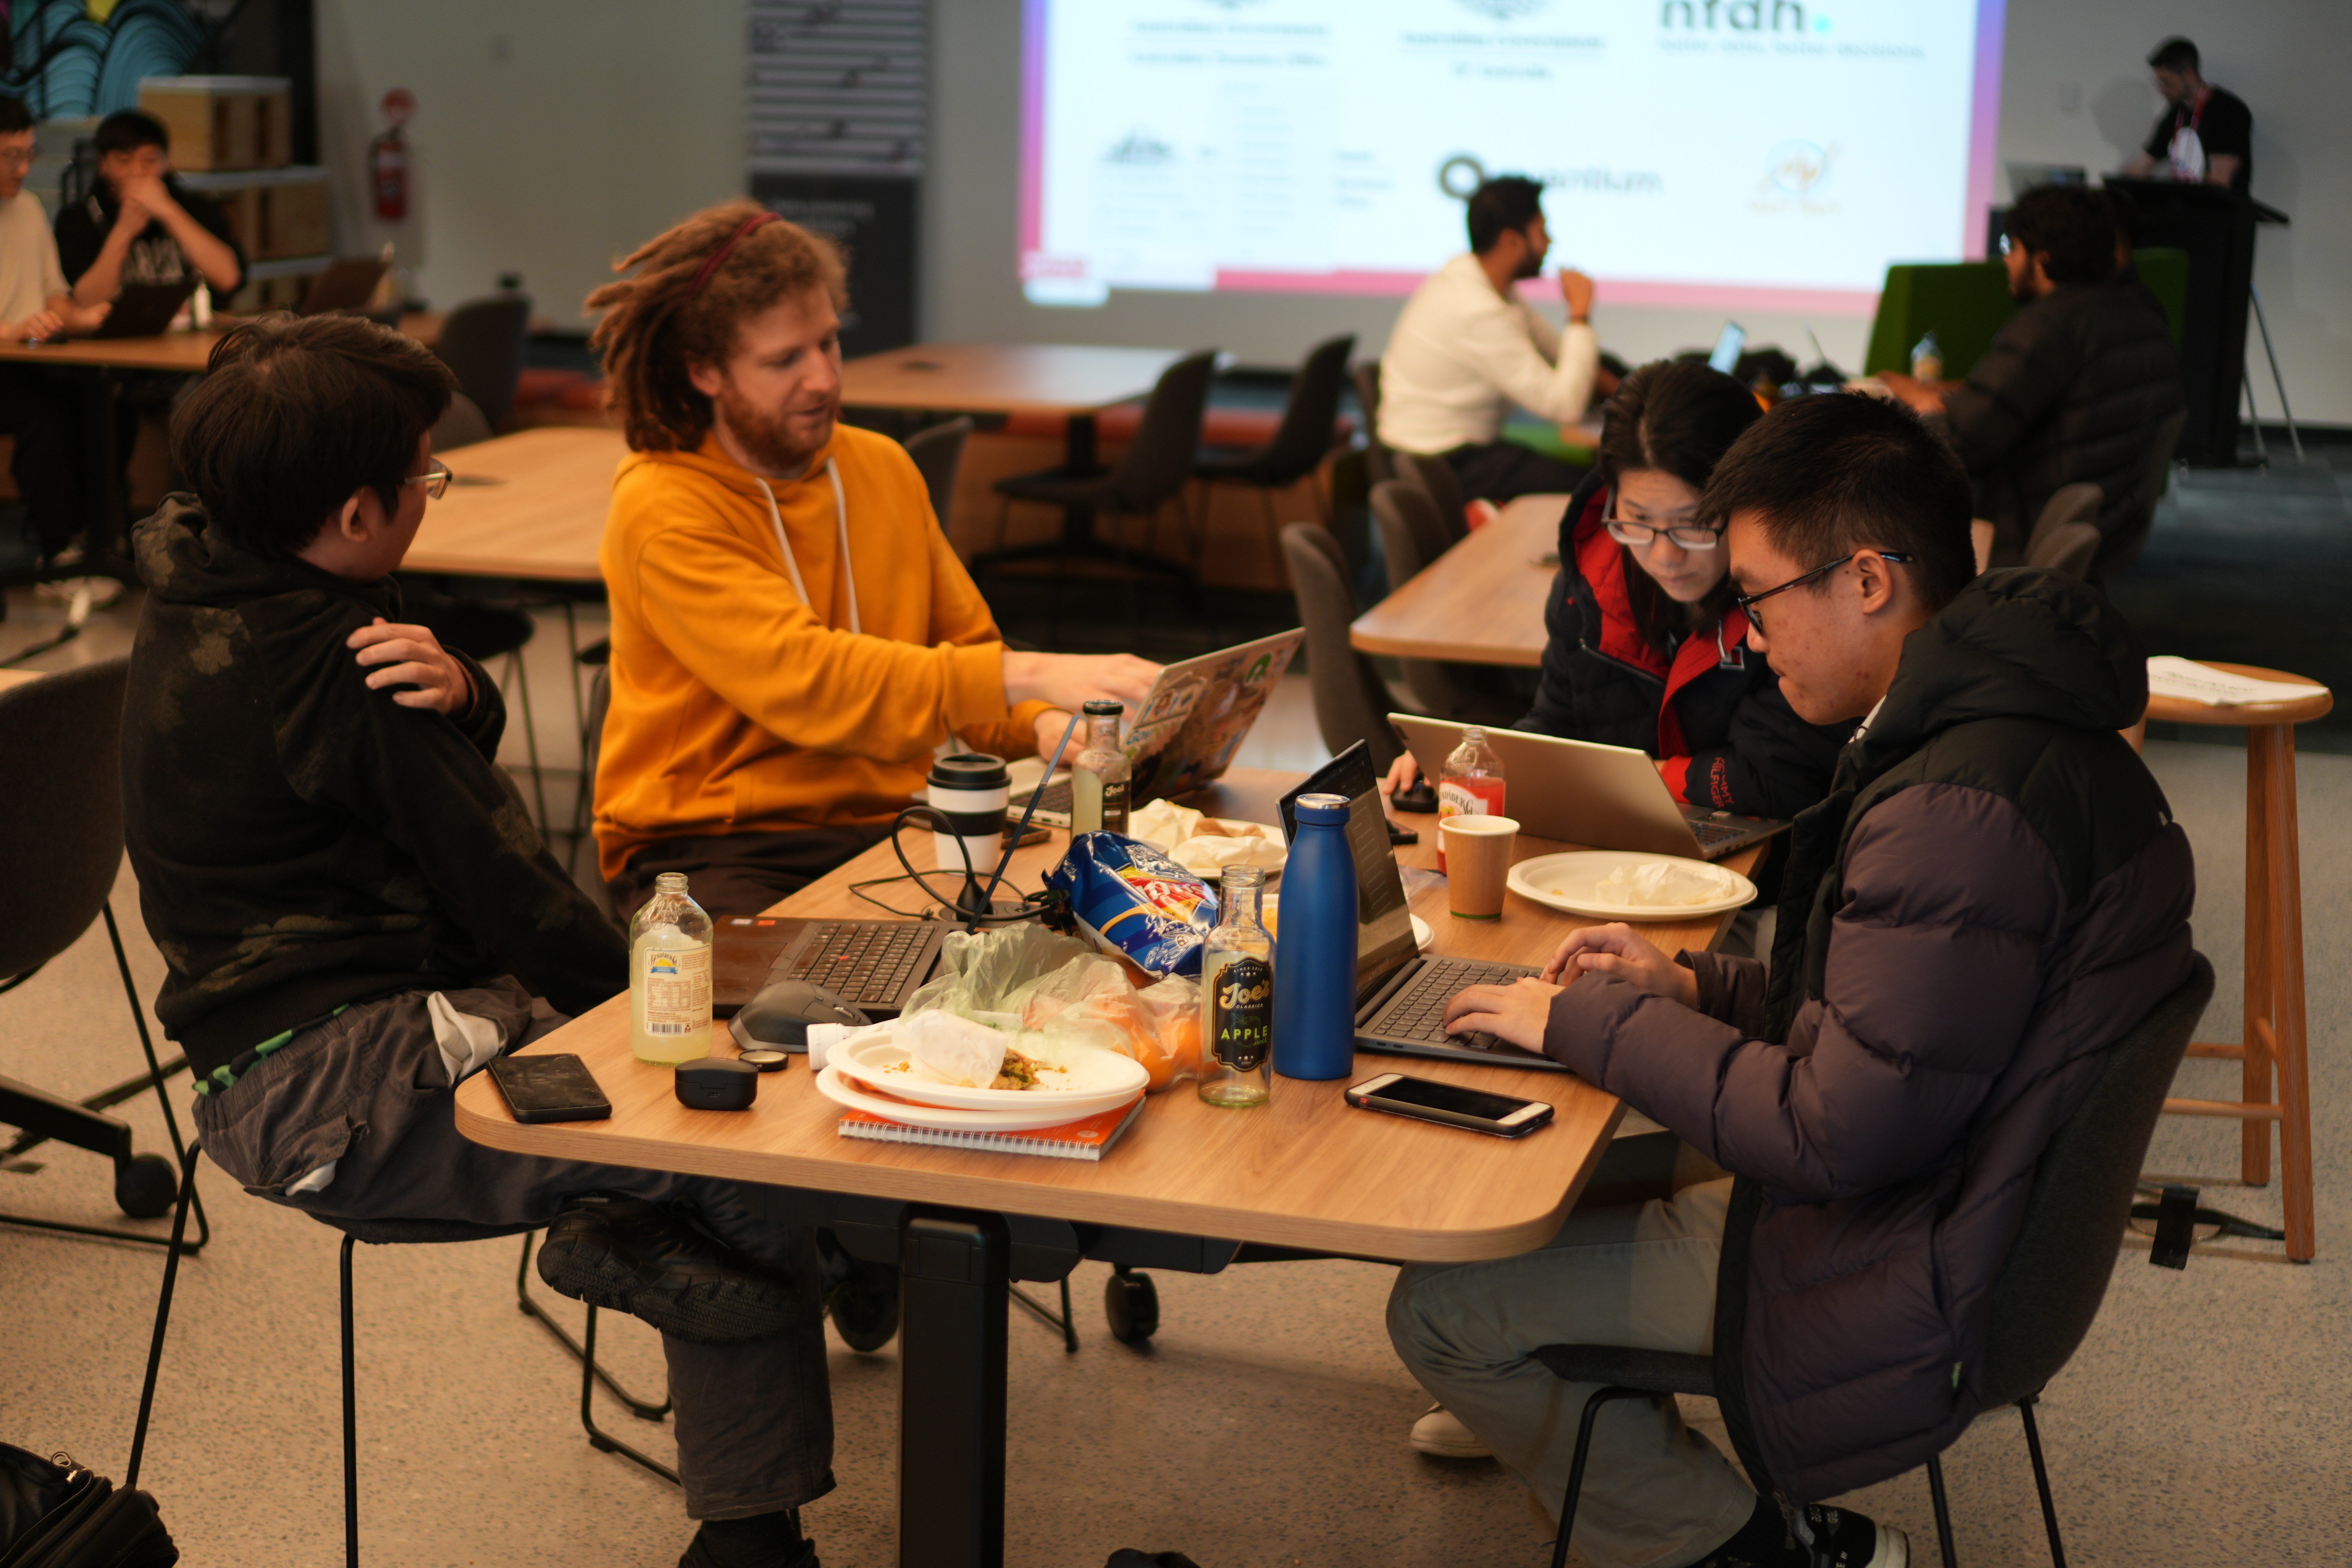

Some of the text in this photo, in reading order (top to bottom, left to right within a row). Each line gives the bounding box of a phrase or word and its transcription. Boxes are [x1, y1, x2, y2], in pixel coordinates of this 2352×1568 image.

[1710, 757, 1724, 808] HILFIGER
[648, 952, 680, 967] BUNDABERG
[1220, 979, 1269, 1009] Joe's
[1221, 1025, 1268, 1040] APPLE
